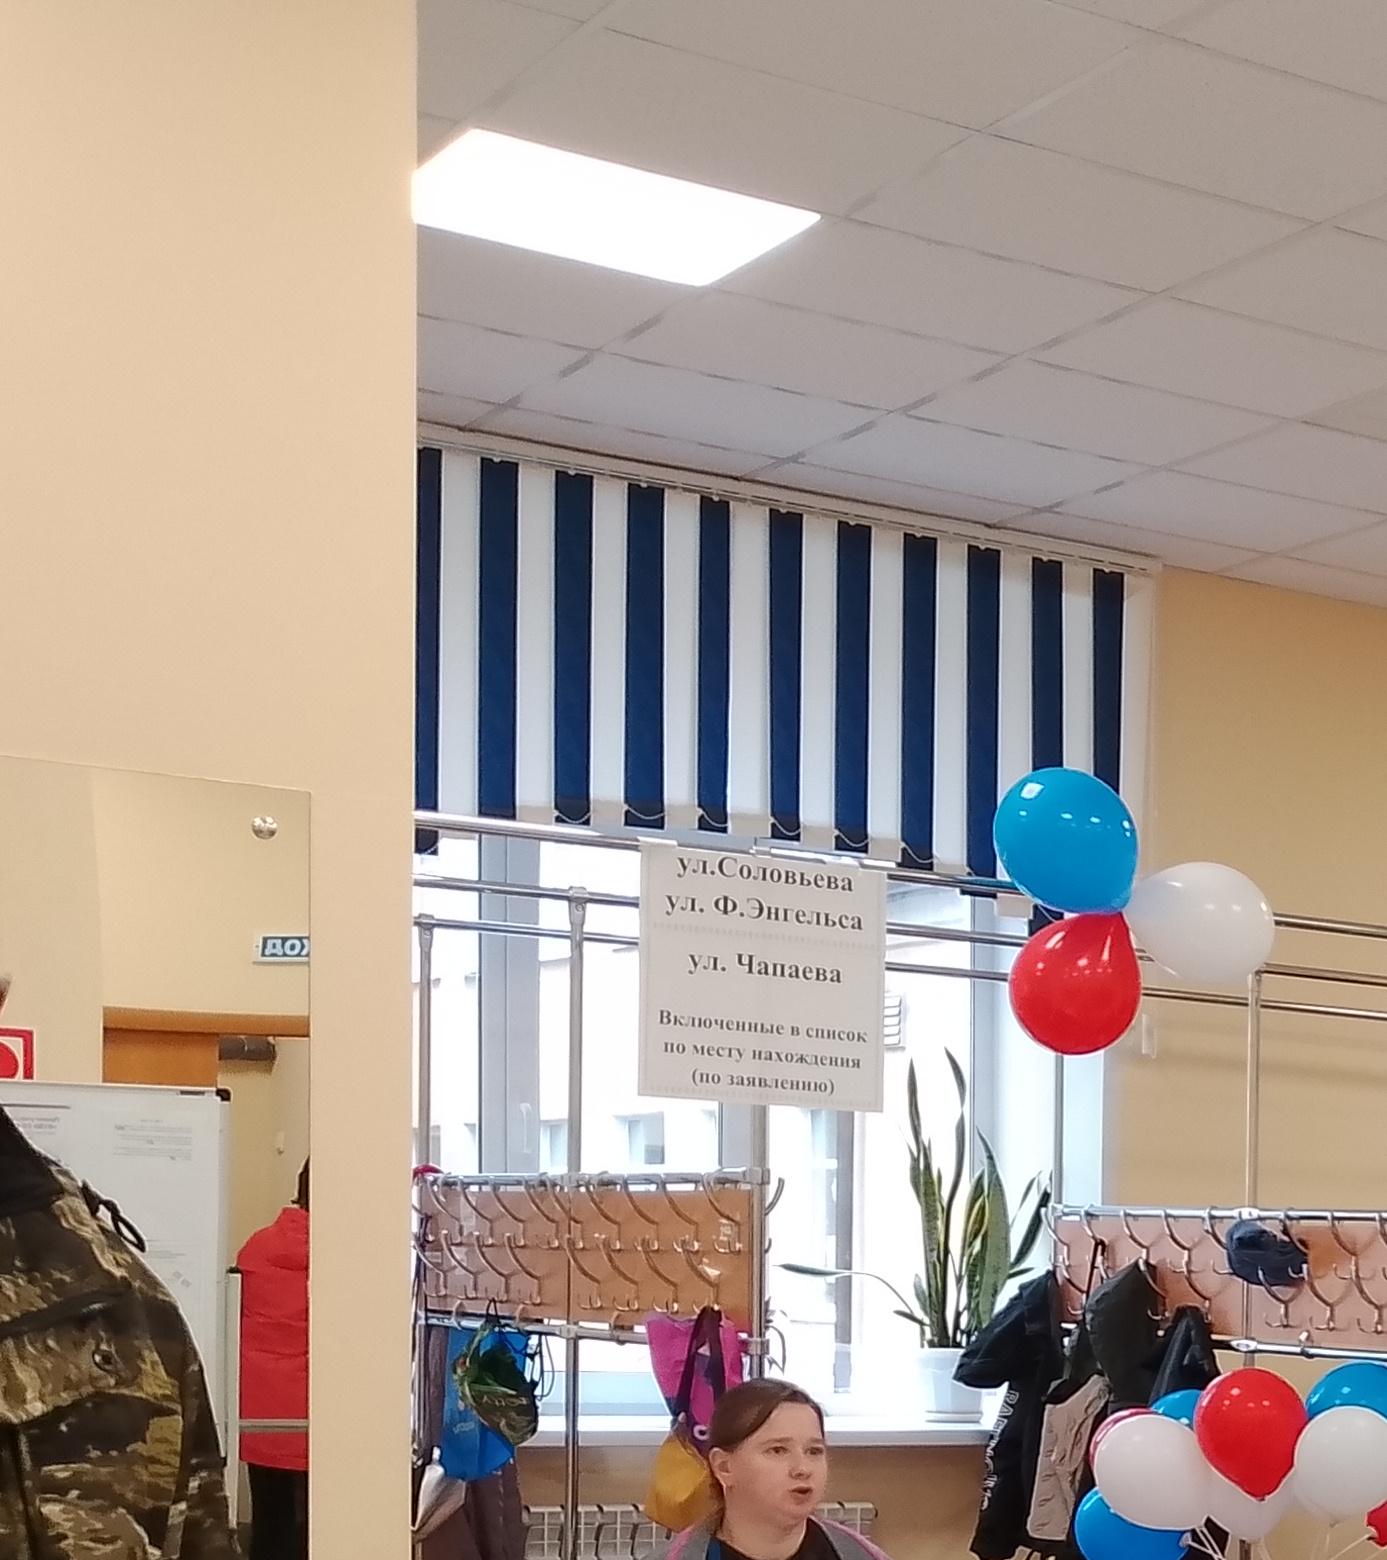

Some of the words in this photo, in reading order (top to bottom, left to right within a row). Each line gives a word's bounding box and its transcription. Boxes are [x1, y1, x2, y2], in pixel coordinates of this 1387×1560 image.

[677, 856, 854, 892] ул.Соловьева
[665, 894, 704, 915] ул.
[714, 896, 863, 930] Ф.Энгельса
[688, 954, 726, 974] ул.
[736, 953, 842, 984] Чапаева
[659, 1010, 784, 1035] Включенные
[790, 1026, 800, 1036] в
[806, 1026, 868, 1043] список
[664, 1042, 685, 1054] по
[692, 1044, 745, 1062] месту
[752, 1049, 860, 1068] нахождения
[692, 1068, 720, 1086] (по
[728, 1074, 834, 1096] заявлению)
